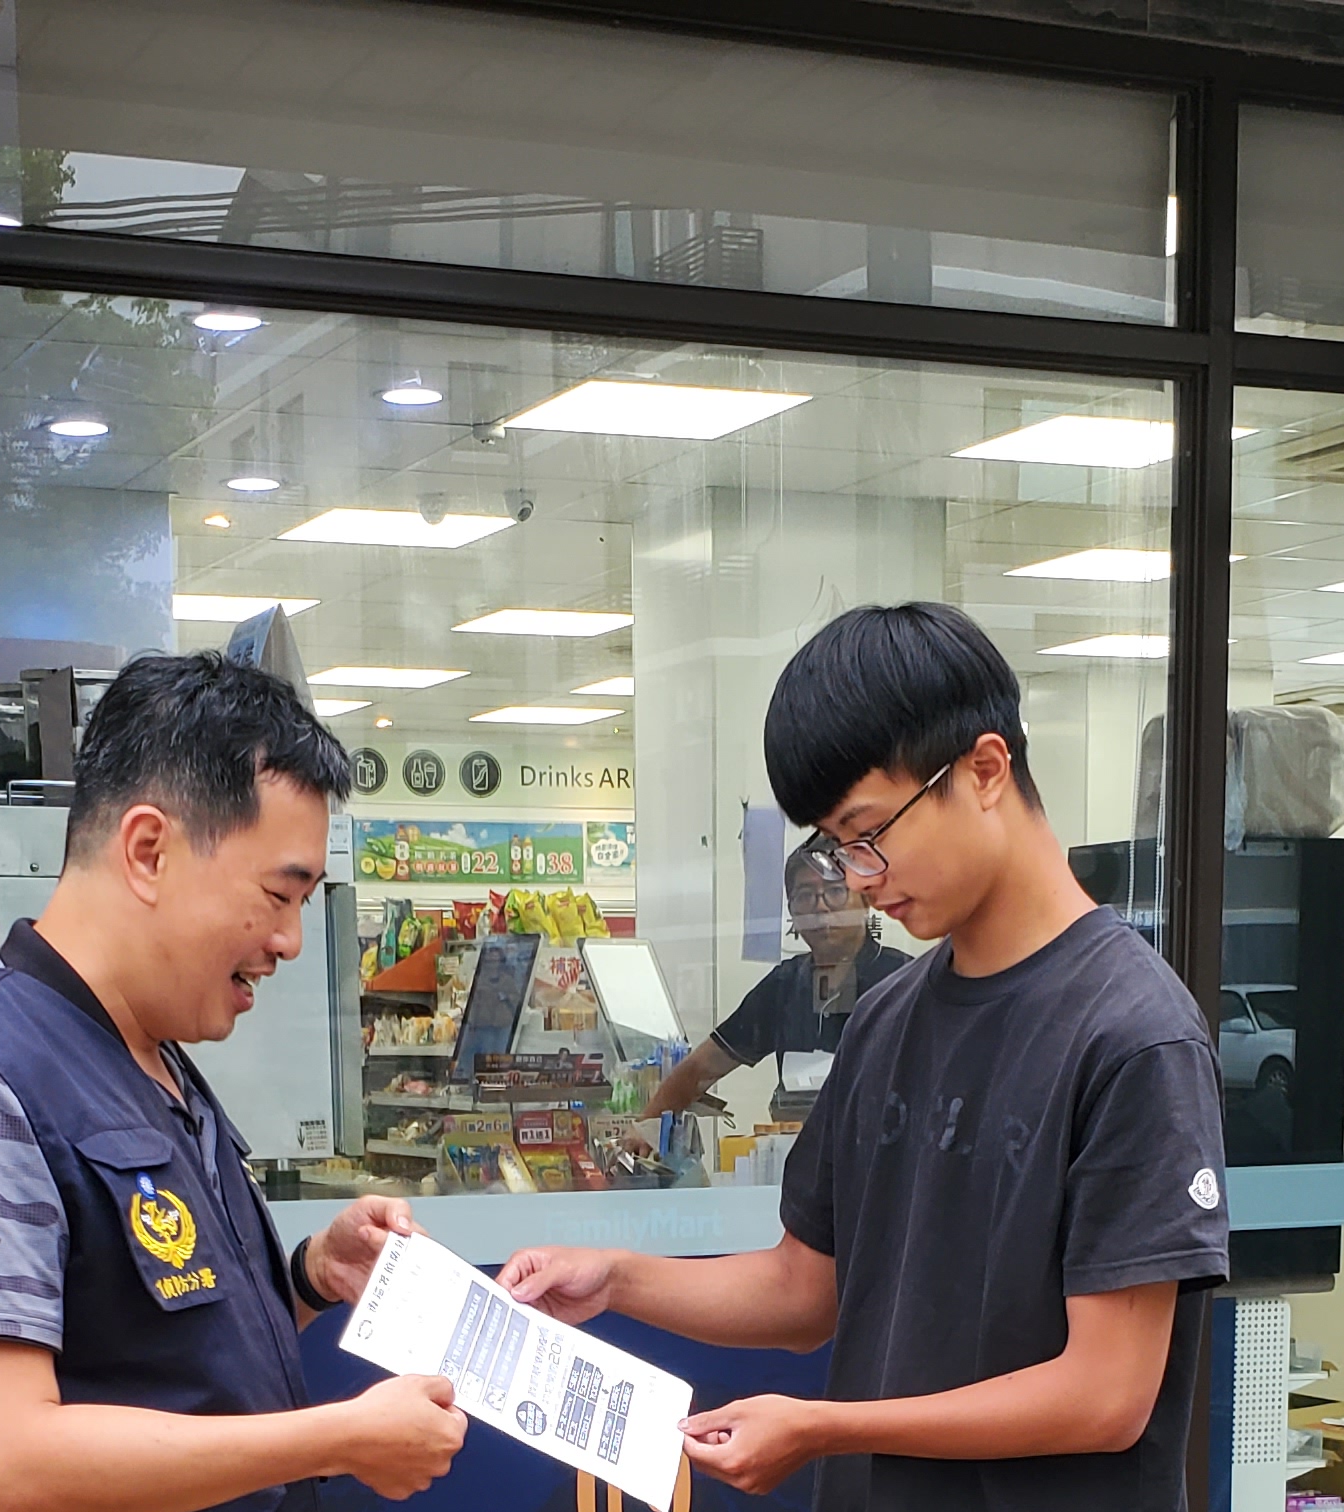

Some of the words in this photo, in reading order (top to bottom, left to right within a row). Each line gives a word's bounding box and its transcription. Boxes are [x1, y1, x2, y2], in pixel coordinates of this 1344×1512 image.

[520, 764, 594, 789] Drinks
[597, 766, 635, 790] AR
[471, 851, 499, 875] 22
[546, 851, 575, 875] 38
[546, 1207, 724, 1248] FamilyMart
